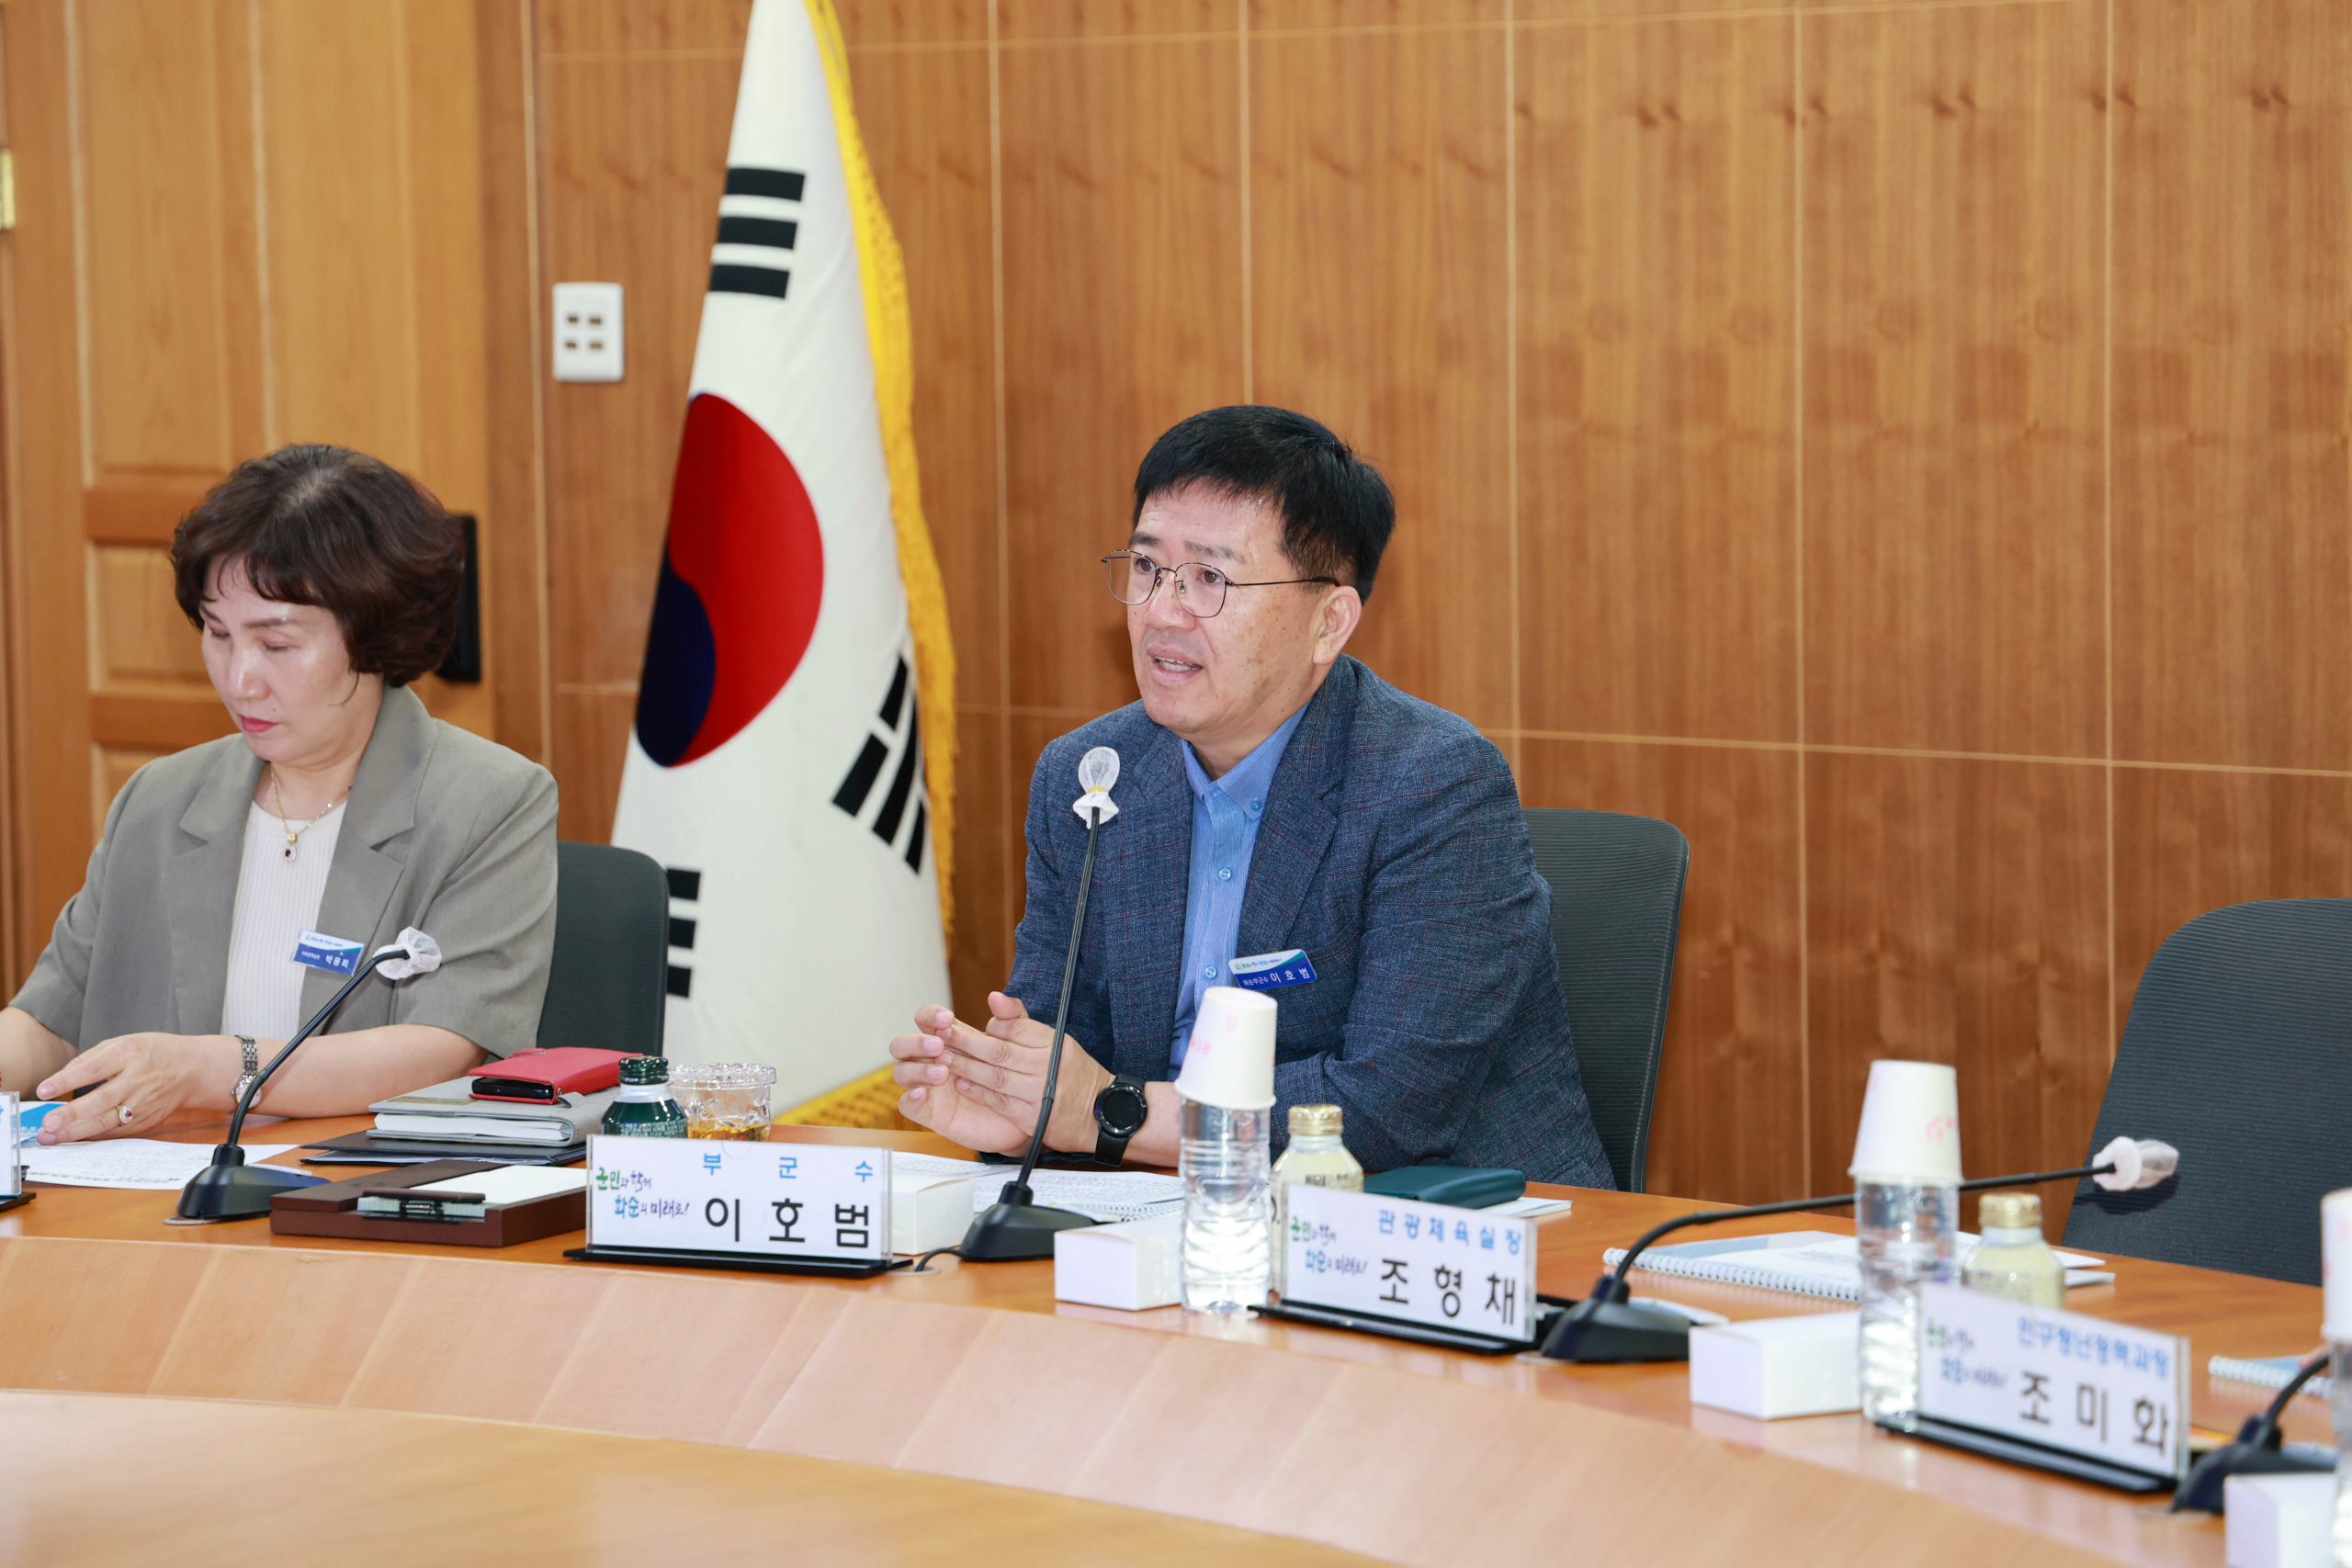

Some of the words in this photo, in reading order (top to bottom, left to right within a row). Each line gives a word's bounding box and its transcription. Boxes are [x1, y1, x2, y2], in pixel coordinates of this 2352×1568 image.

[1270, 967, 1311, 983] 이호범
[595, 1167, 628, 1190] 군민과
[703, 1153, 874, 1182] 부군수
[615, 1194, 647, 1219] 화순의
[705, 1197, 869, 1248] 이호범
[1379, 1209, 1521, 1255] 관광체육실장
[1379, 1258, 1516, 1325] 조형채
